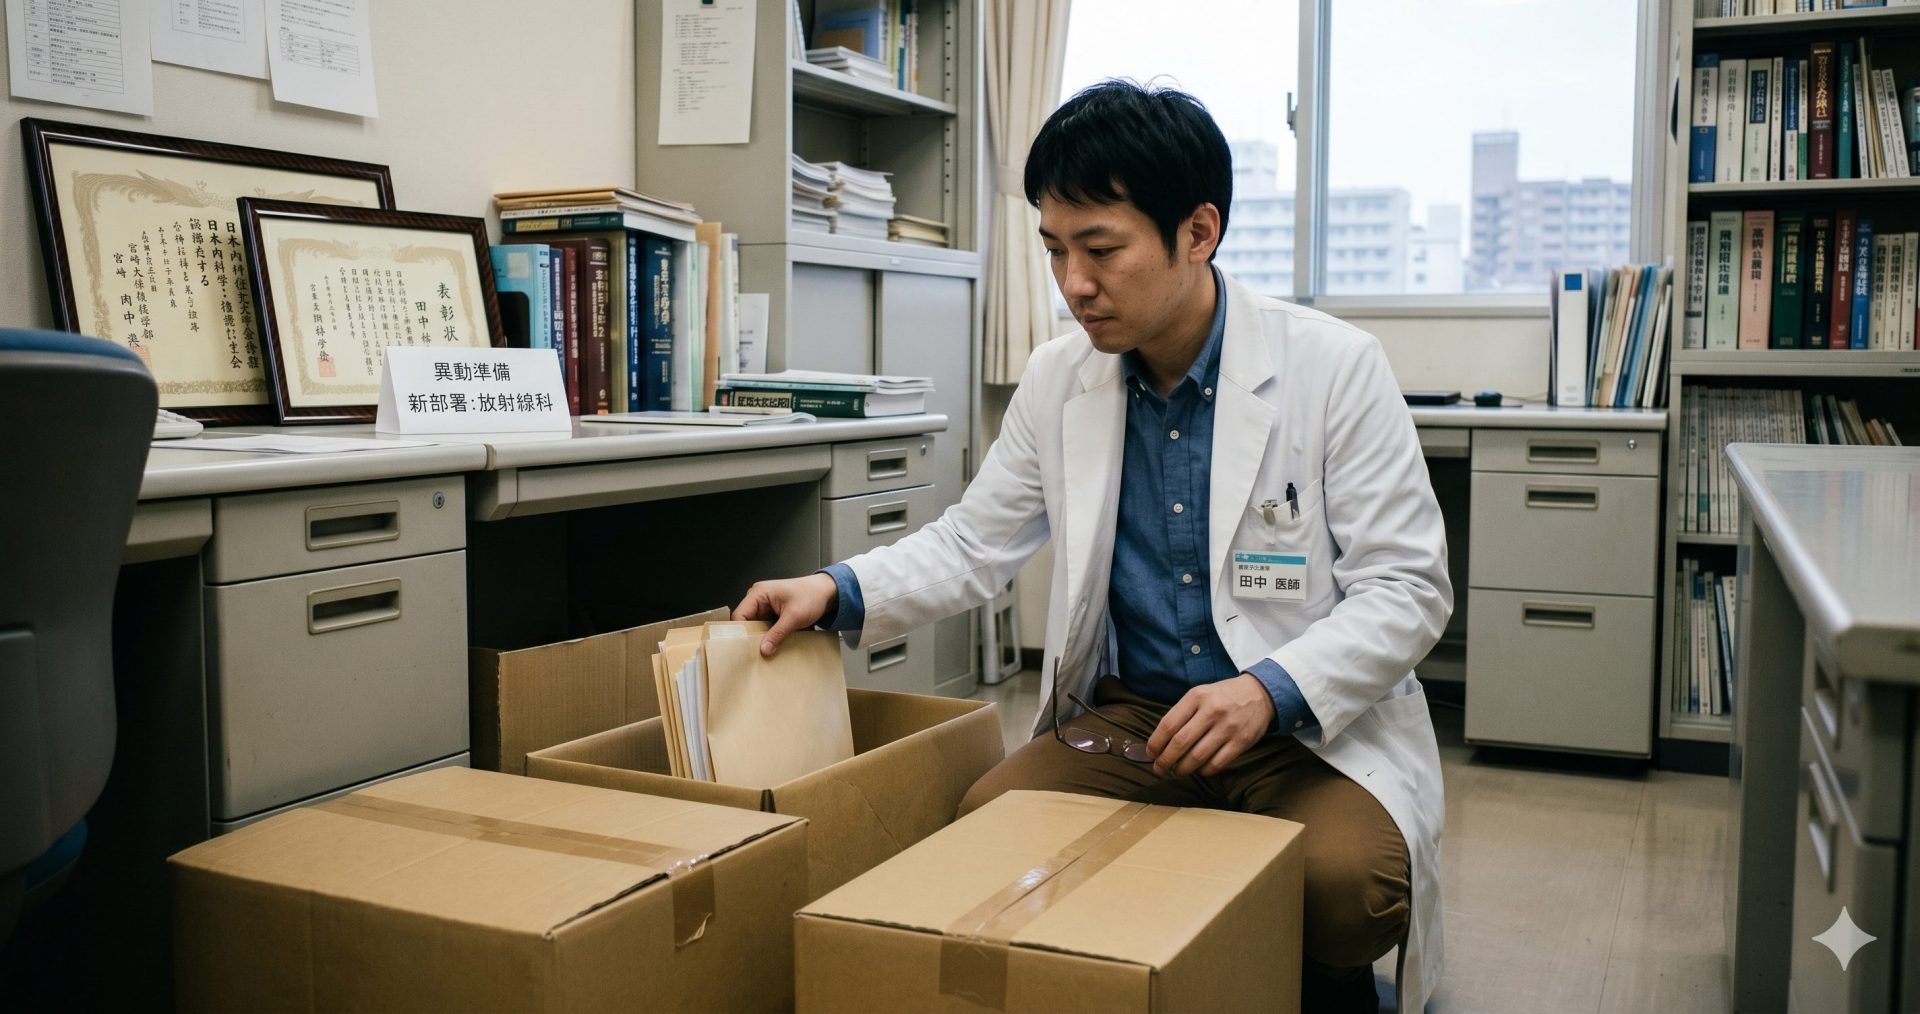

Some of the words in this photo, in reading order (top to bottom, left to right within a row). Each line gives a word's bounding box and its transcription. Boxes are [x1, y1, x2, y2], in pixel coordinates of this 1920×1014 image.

[436, 282, 459, 342] 表彰状
[434, 362, 511, 382] 異動準備
[408, 392, 553, 413] 新部署:放射線科
[1240, 575, 1267, 589] 田中
[1275, 577, 1300, 590] 医師
